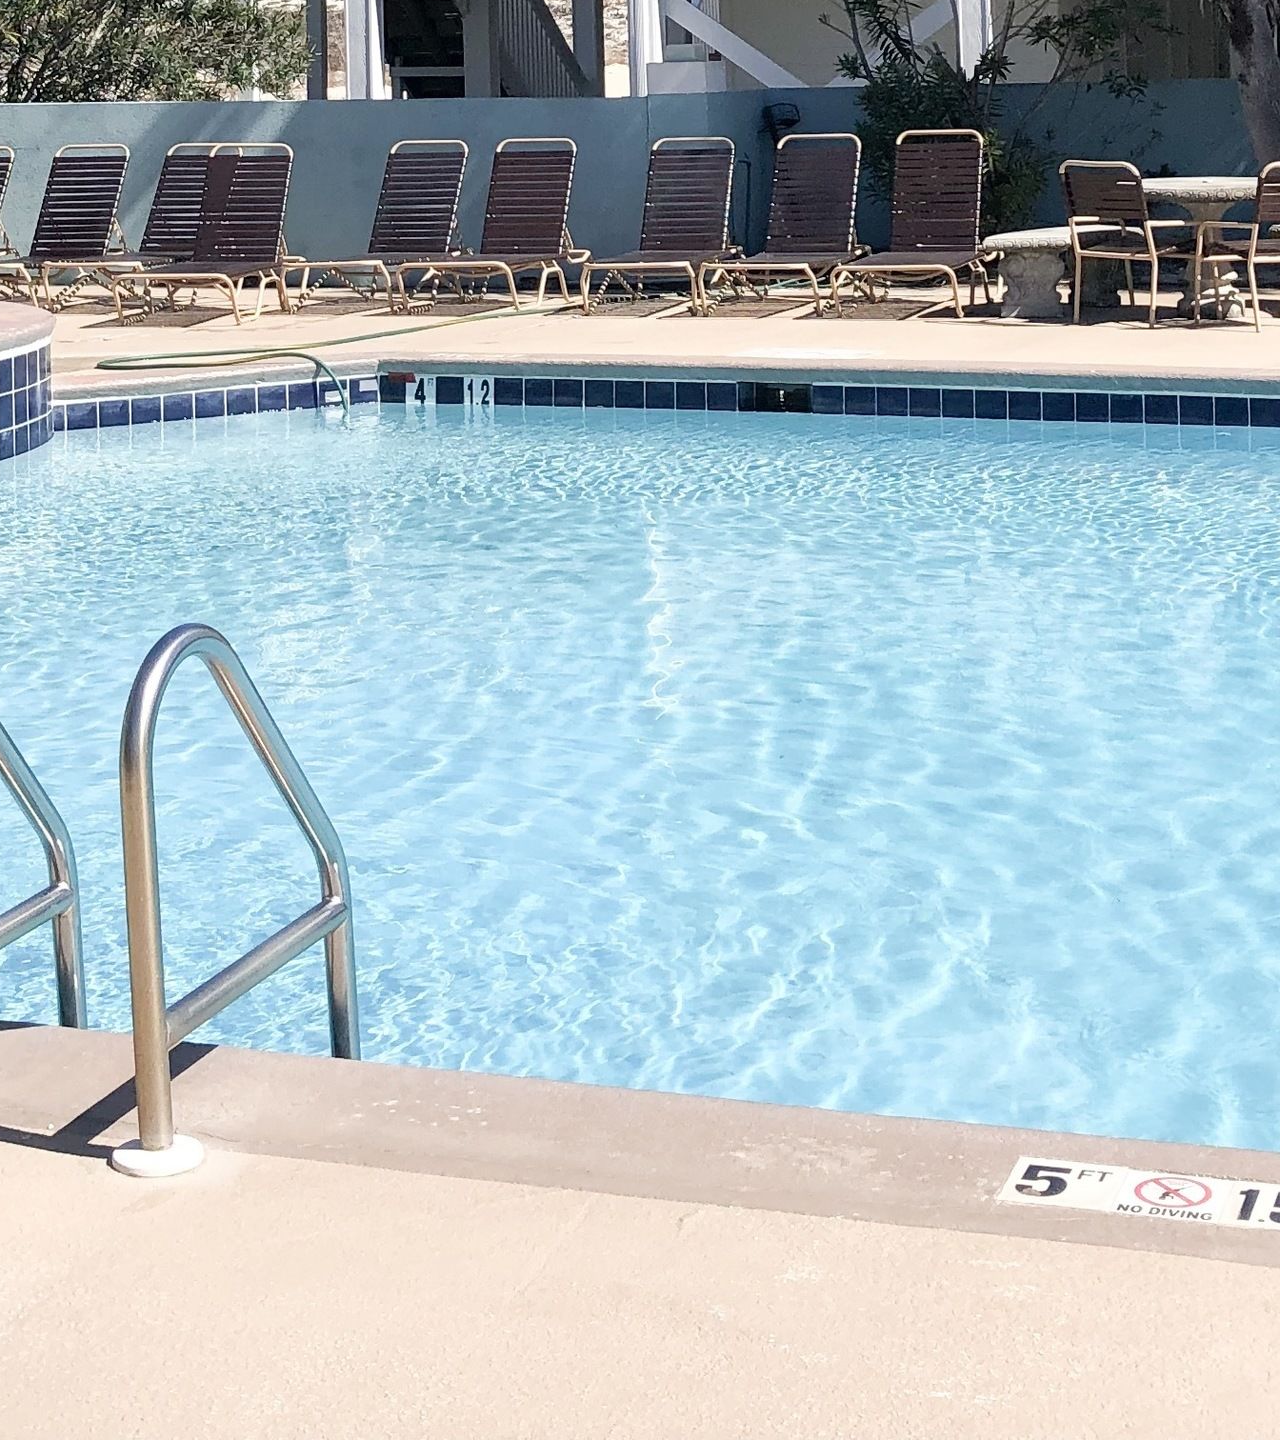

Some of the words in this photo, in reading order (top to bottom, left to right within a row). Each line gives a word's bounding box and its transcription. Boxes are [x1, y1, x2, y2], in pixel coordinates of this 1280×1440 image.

[414, 377, 426, 404] 4
[1015, 1164, 1072, 1197] 5
[1076, 1168, 1113, 1183] FT
[1116, 1202, 1143, 1214] NO
[1148, 1207, 1213, 1222] DIVING
